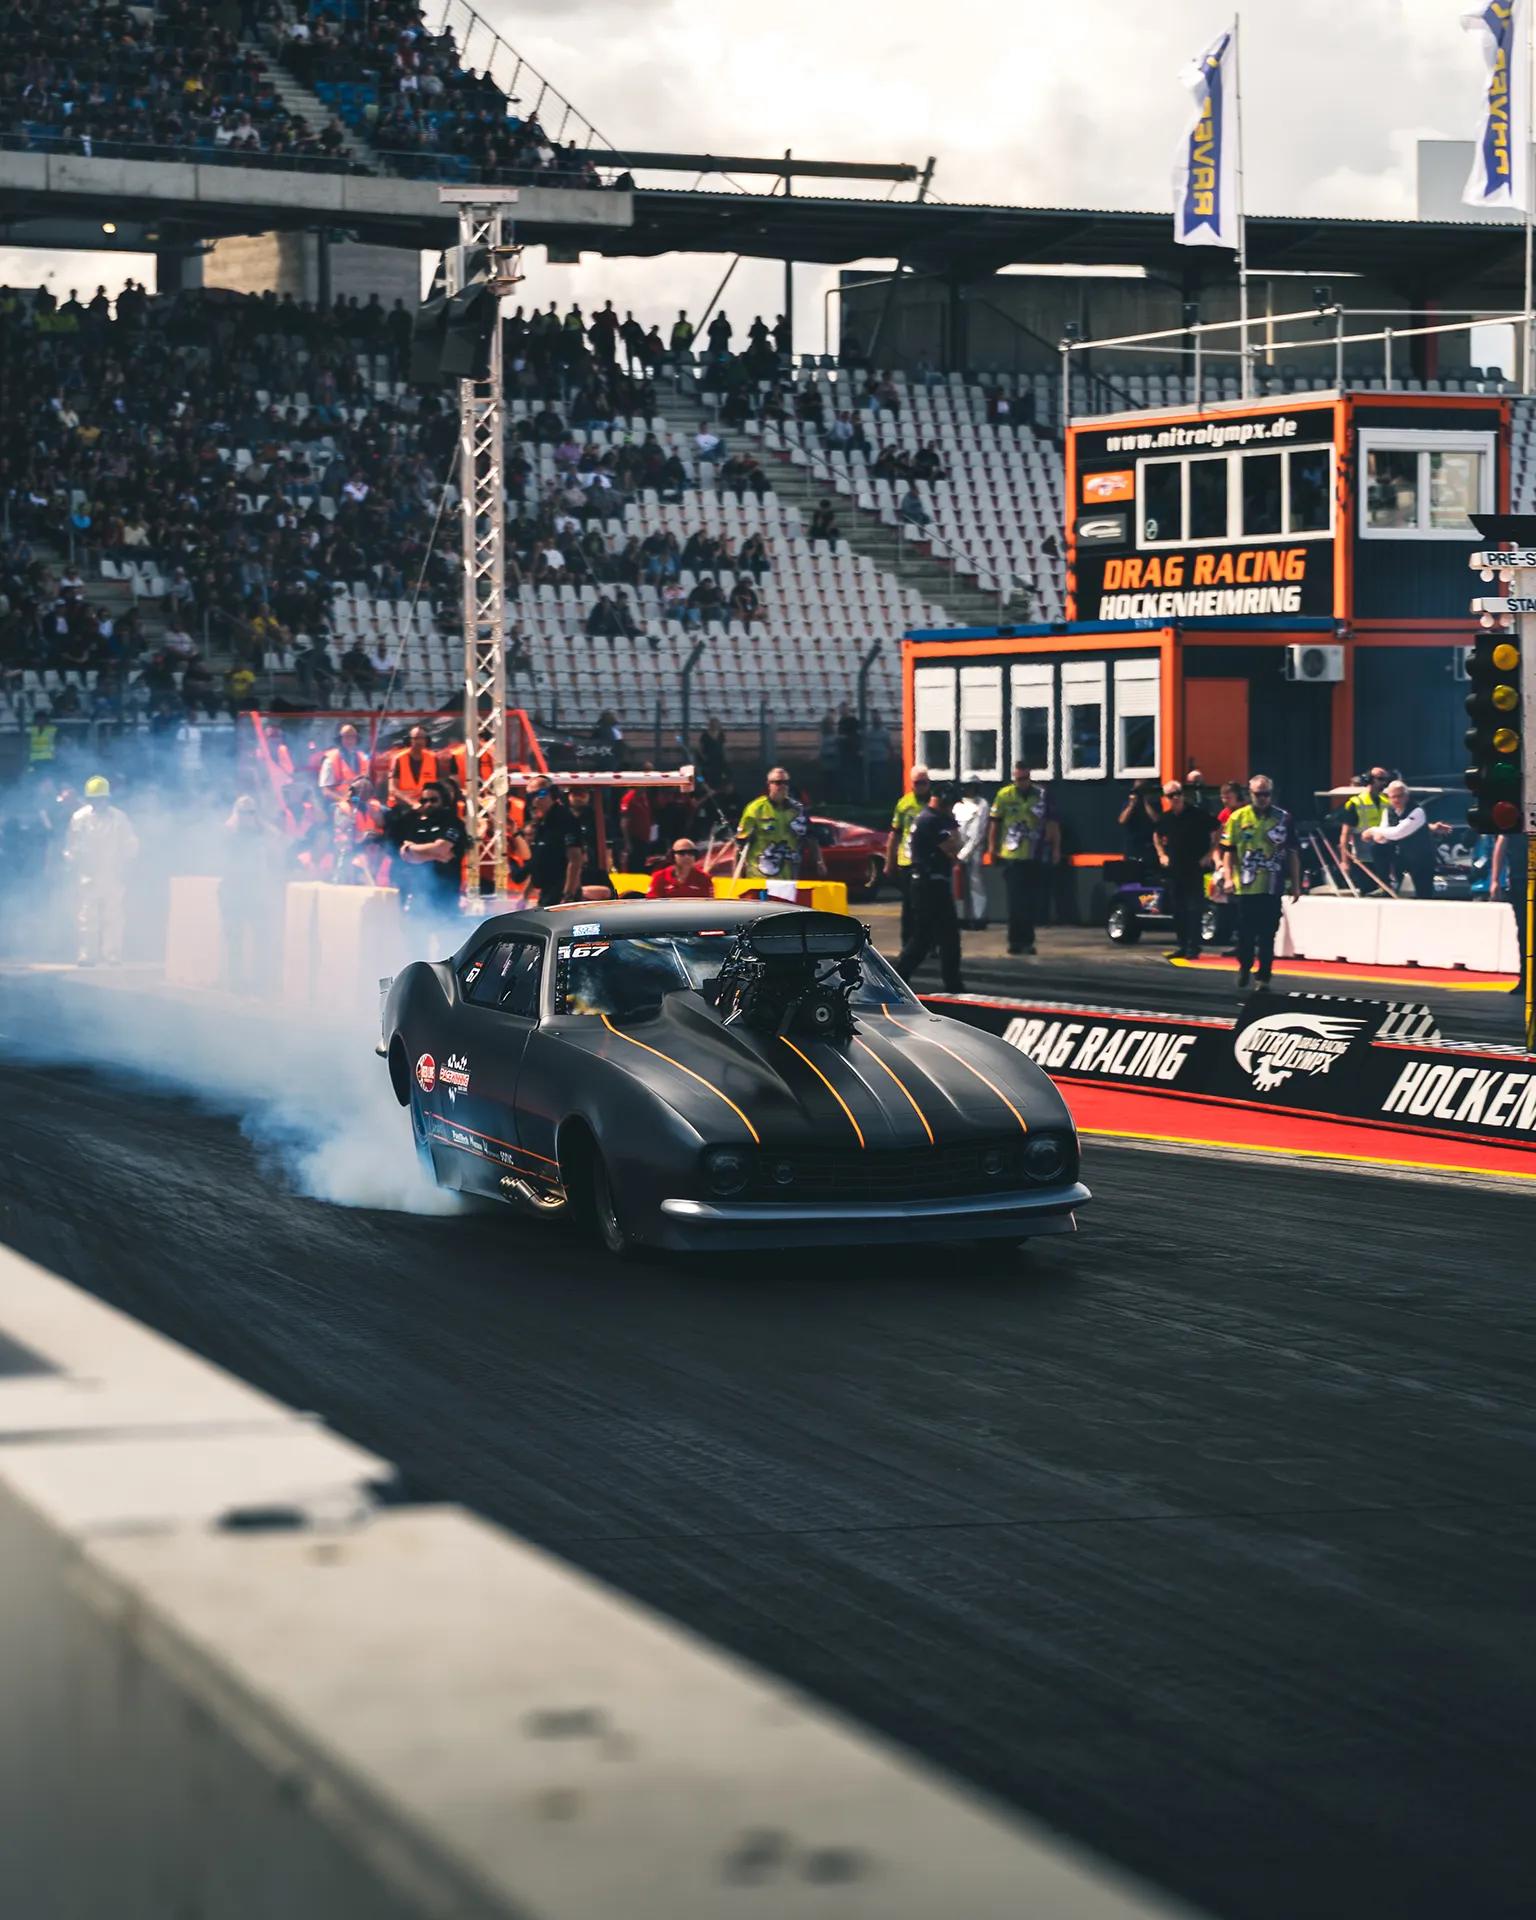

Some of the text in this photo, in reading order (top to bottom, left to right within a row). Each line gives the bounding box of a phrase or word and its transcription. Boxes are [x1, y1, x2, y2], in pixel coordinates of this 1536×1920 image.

[1107, 417, 1297, 452] www.nitrolympx.de
[1103, 549, 1307, 590] DRAG RACING
[1487, 553, 1536, 566] PRE-S
[1099, 585, 1302, 620] HOCKENHEIMRING
[572, 946, 610, 958] 67
[1001, 1017, 1198, 1081] DRAG RACING
